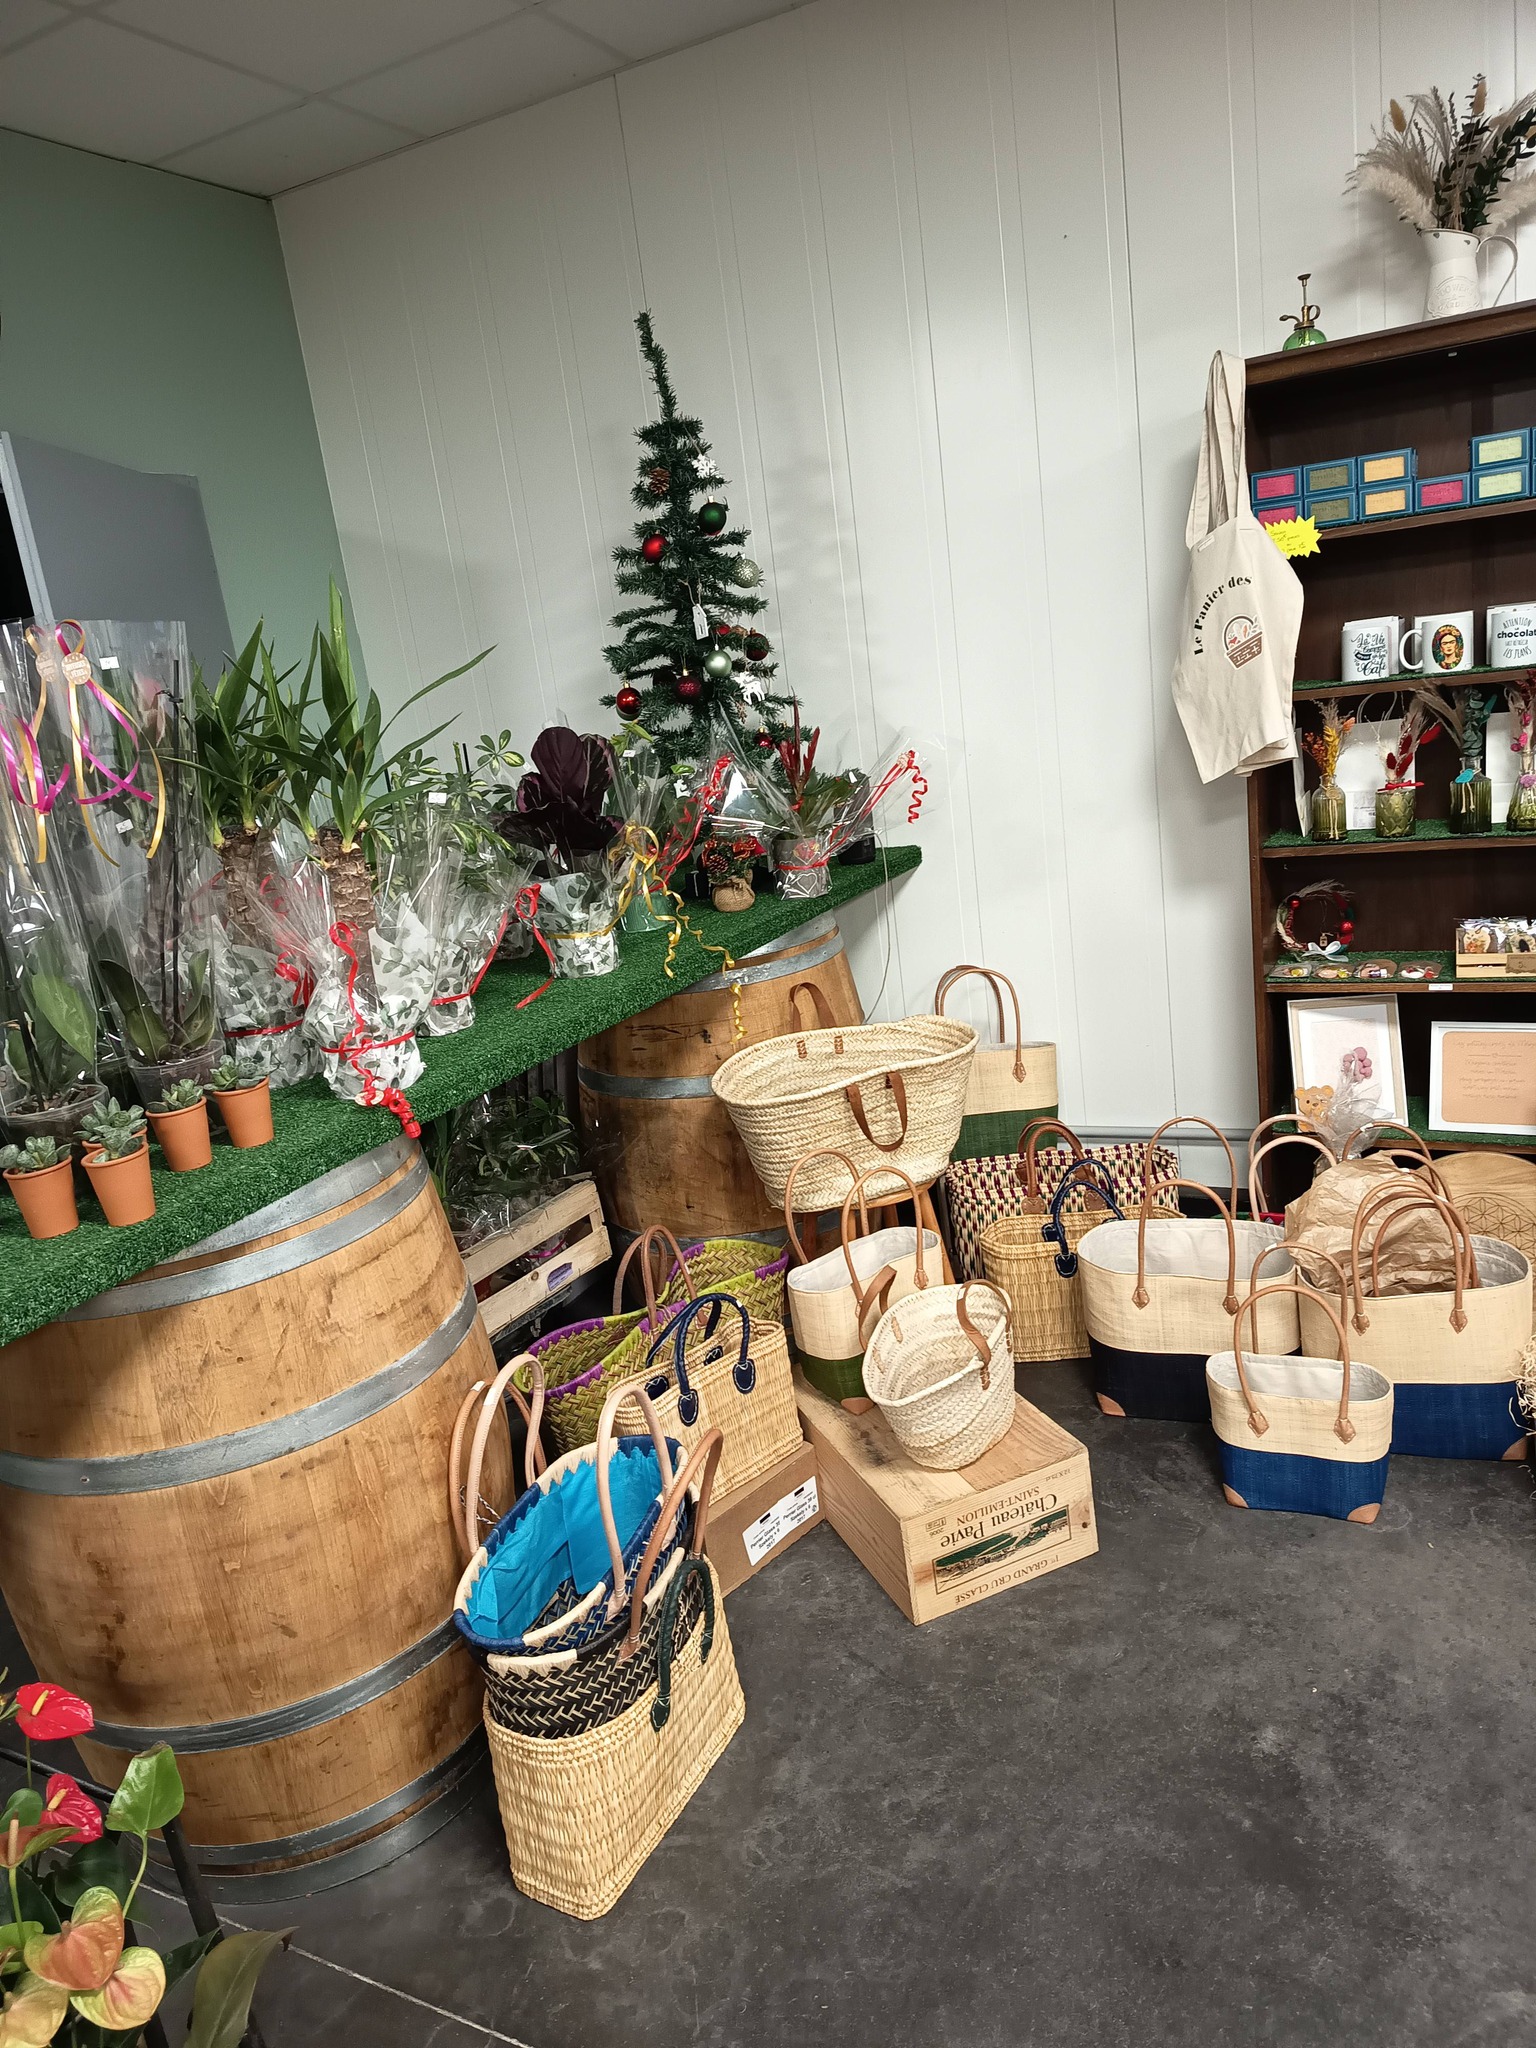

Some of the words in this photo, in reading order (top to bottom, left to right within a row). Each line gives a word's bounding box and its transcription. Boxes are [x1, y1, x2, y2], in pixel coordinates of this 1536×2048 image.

[1227, 575, 1252, 589] des
[1194, 584, 1226, 631] Panier
[1194, 635, 1204, 655] Le
[956, 1485, 1041, 1526] SAINT-EMILION
[991, 1493, 1058, 1527] Château
[940, 1520, 985, 1548] Pavie
[1013, 1559, 1048, 1579] GRAND
[991, 1574, 1012, 1590] CRU
